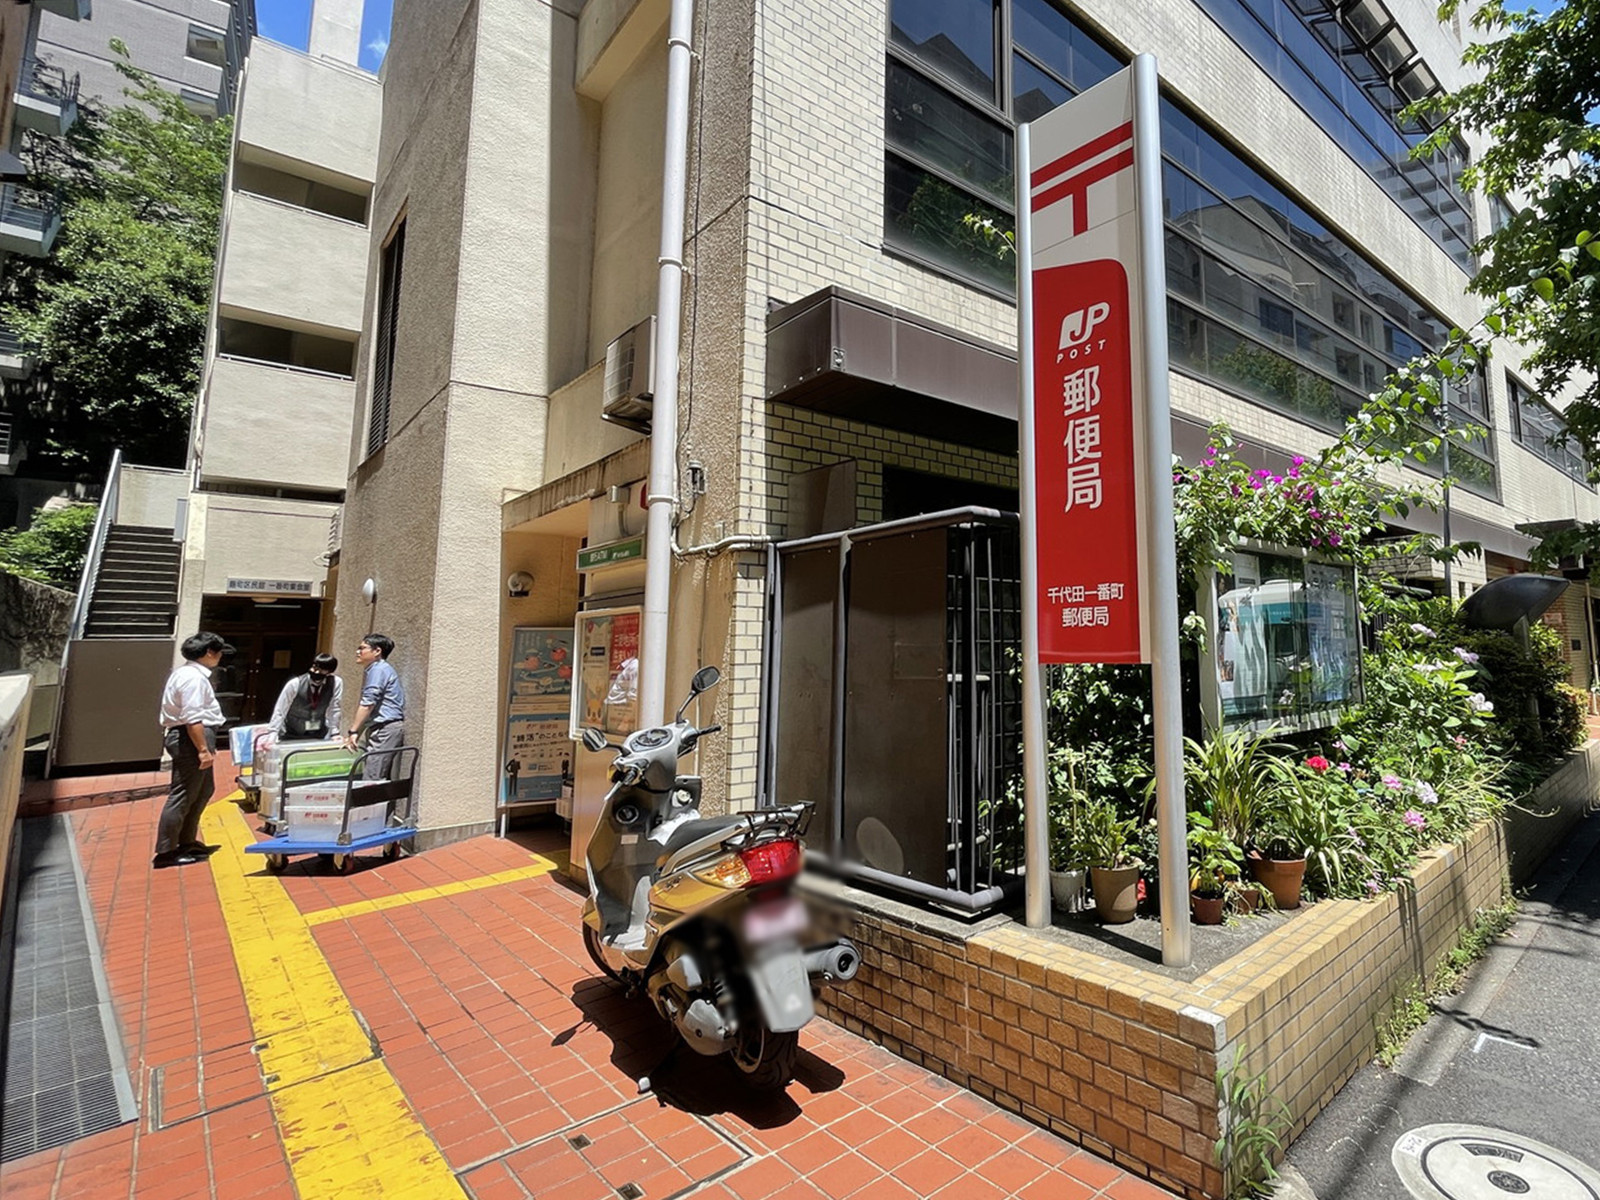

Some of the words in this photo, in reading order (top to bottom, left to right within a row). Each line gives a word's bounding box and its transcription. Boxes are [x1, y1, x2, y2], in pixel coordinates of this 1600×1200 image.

[1059, 302, 1110, 350] JP
[1056, 339, 1106, 364] POST
[1063, 364, 1103, 513] 郵便局
[1047, 582, 1124, 604] 千代田一番町
[1062, 606, 1109, 627] 郵便局
